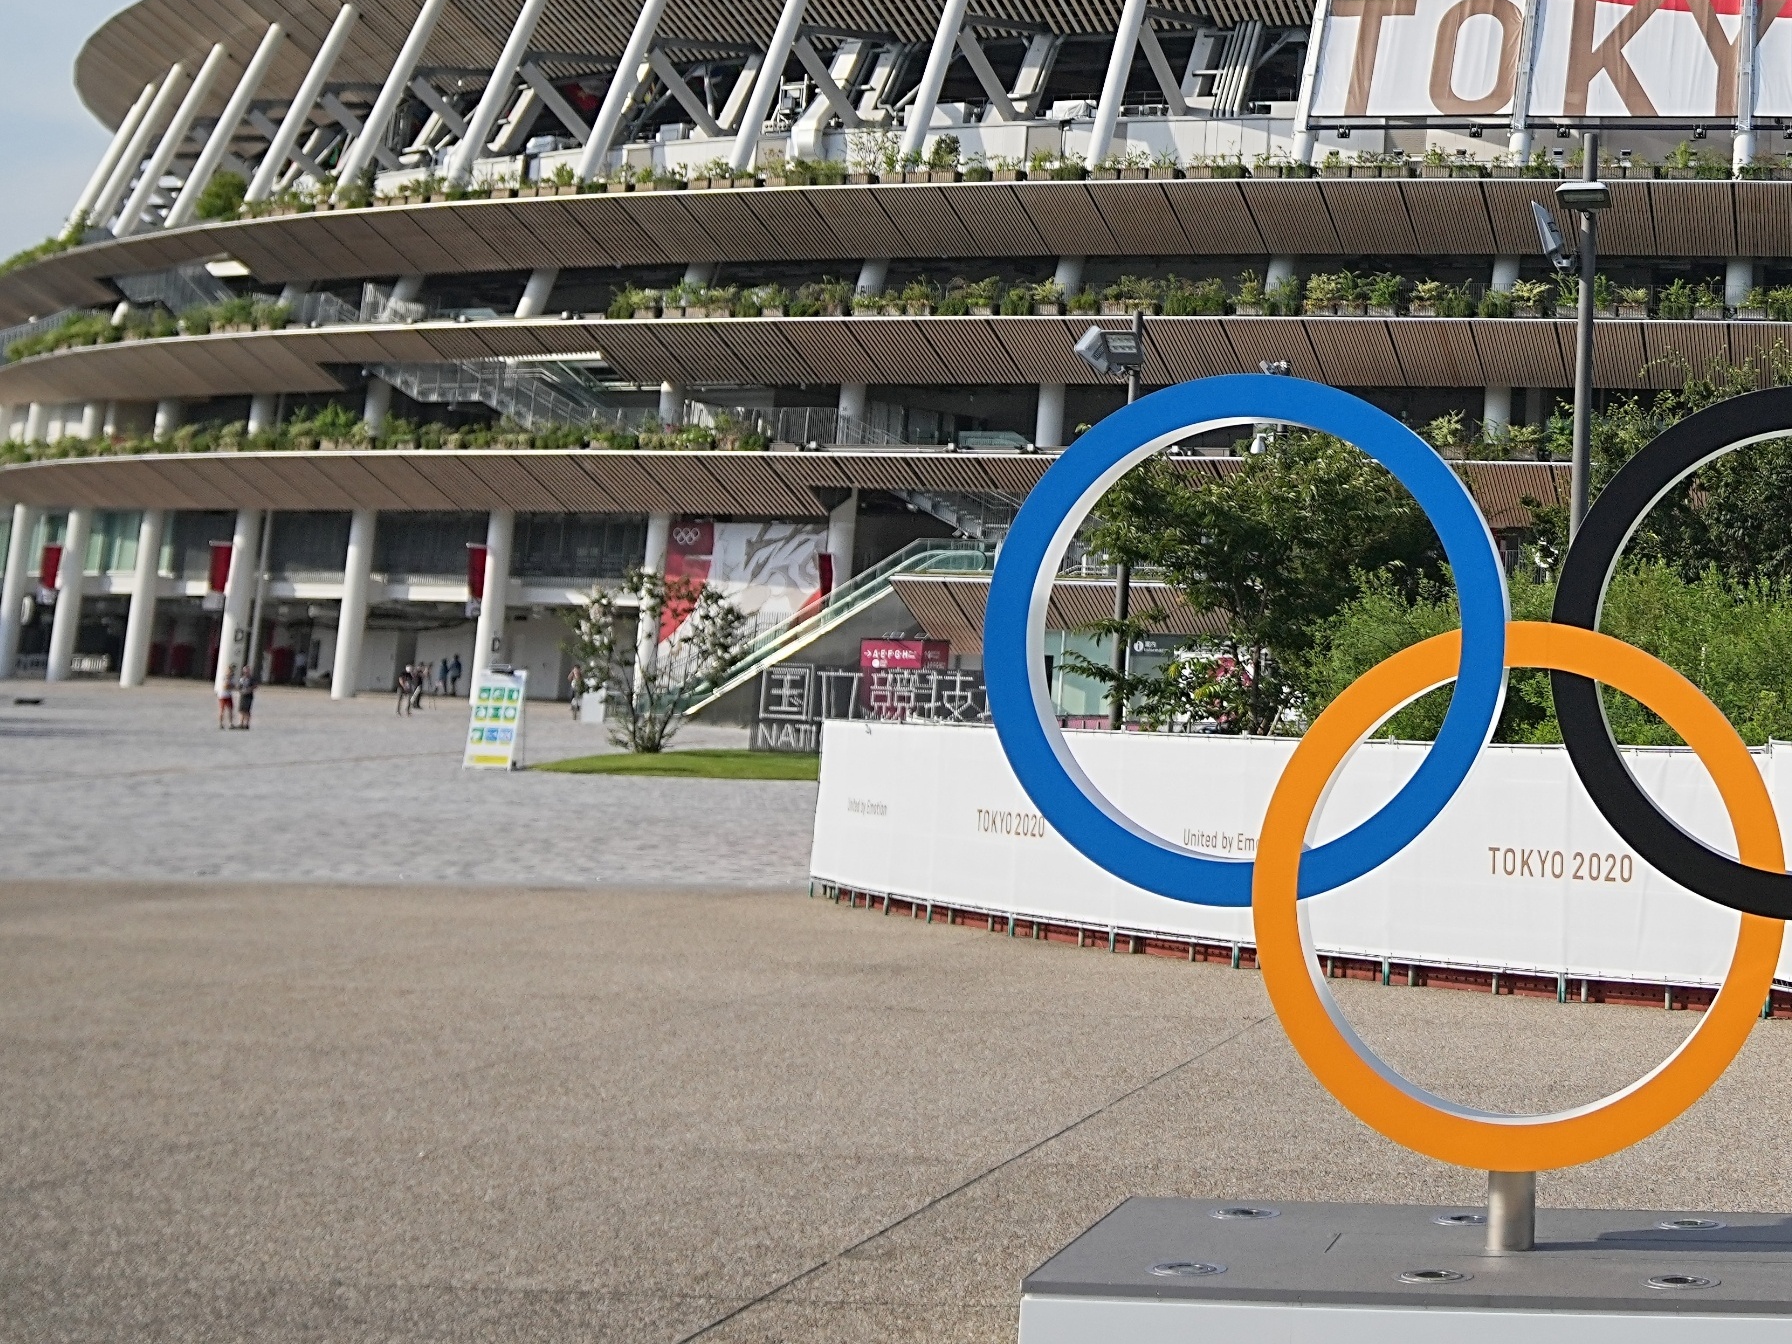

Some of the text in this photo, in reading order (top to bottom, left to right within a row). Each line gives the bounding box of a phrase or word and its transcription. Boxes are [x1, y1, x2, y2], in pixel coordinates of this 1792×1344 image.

[758, 666, 992, 721] 国立競技
[757, 722, 824, 748] NATI
[977, 808, 1045, 838] TOKYO 2020
[1183, 828, 1218, 848] United
[1221, 831, 1234, 853] by
[1488, 846, 1633, 883] TOKYO 2020
